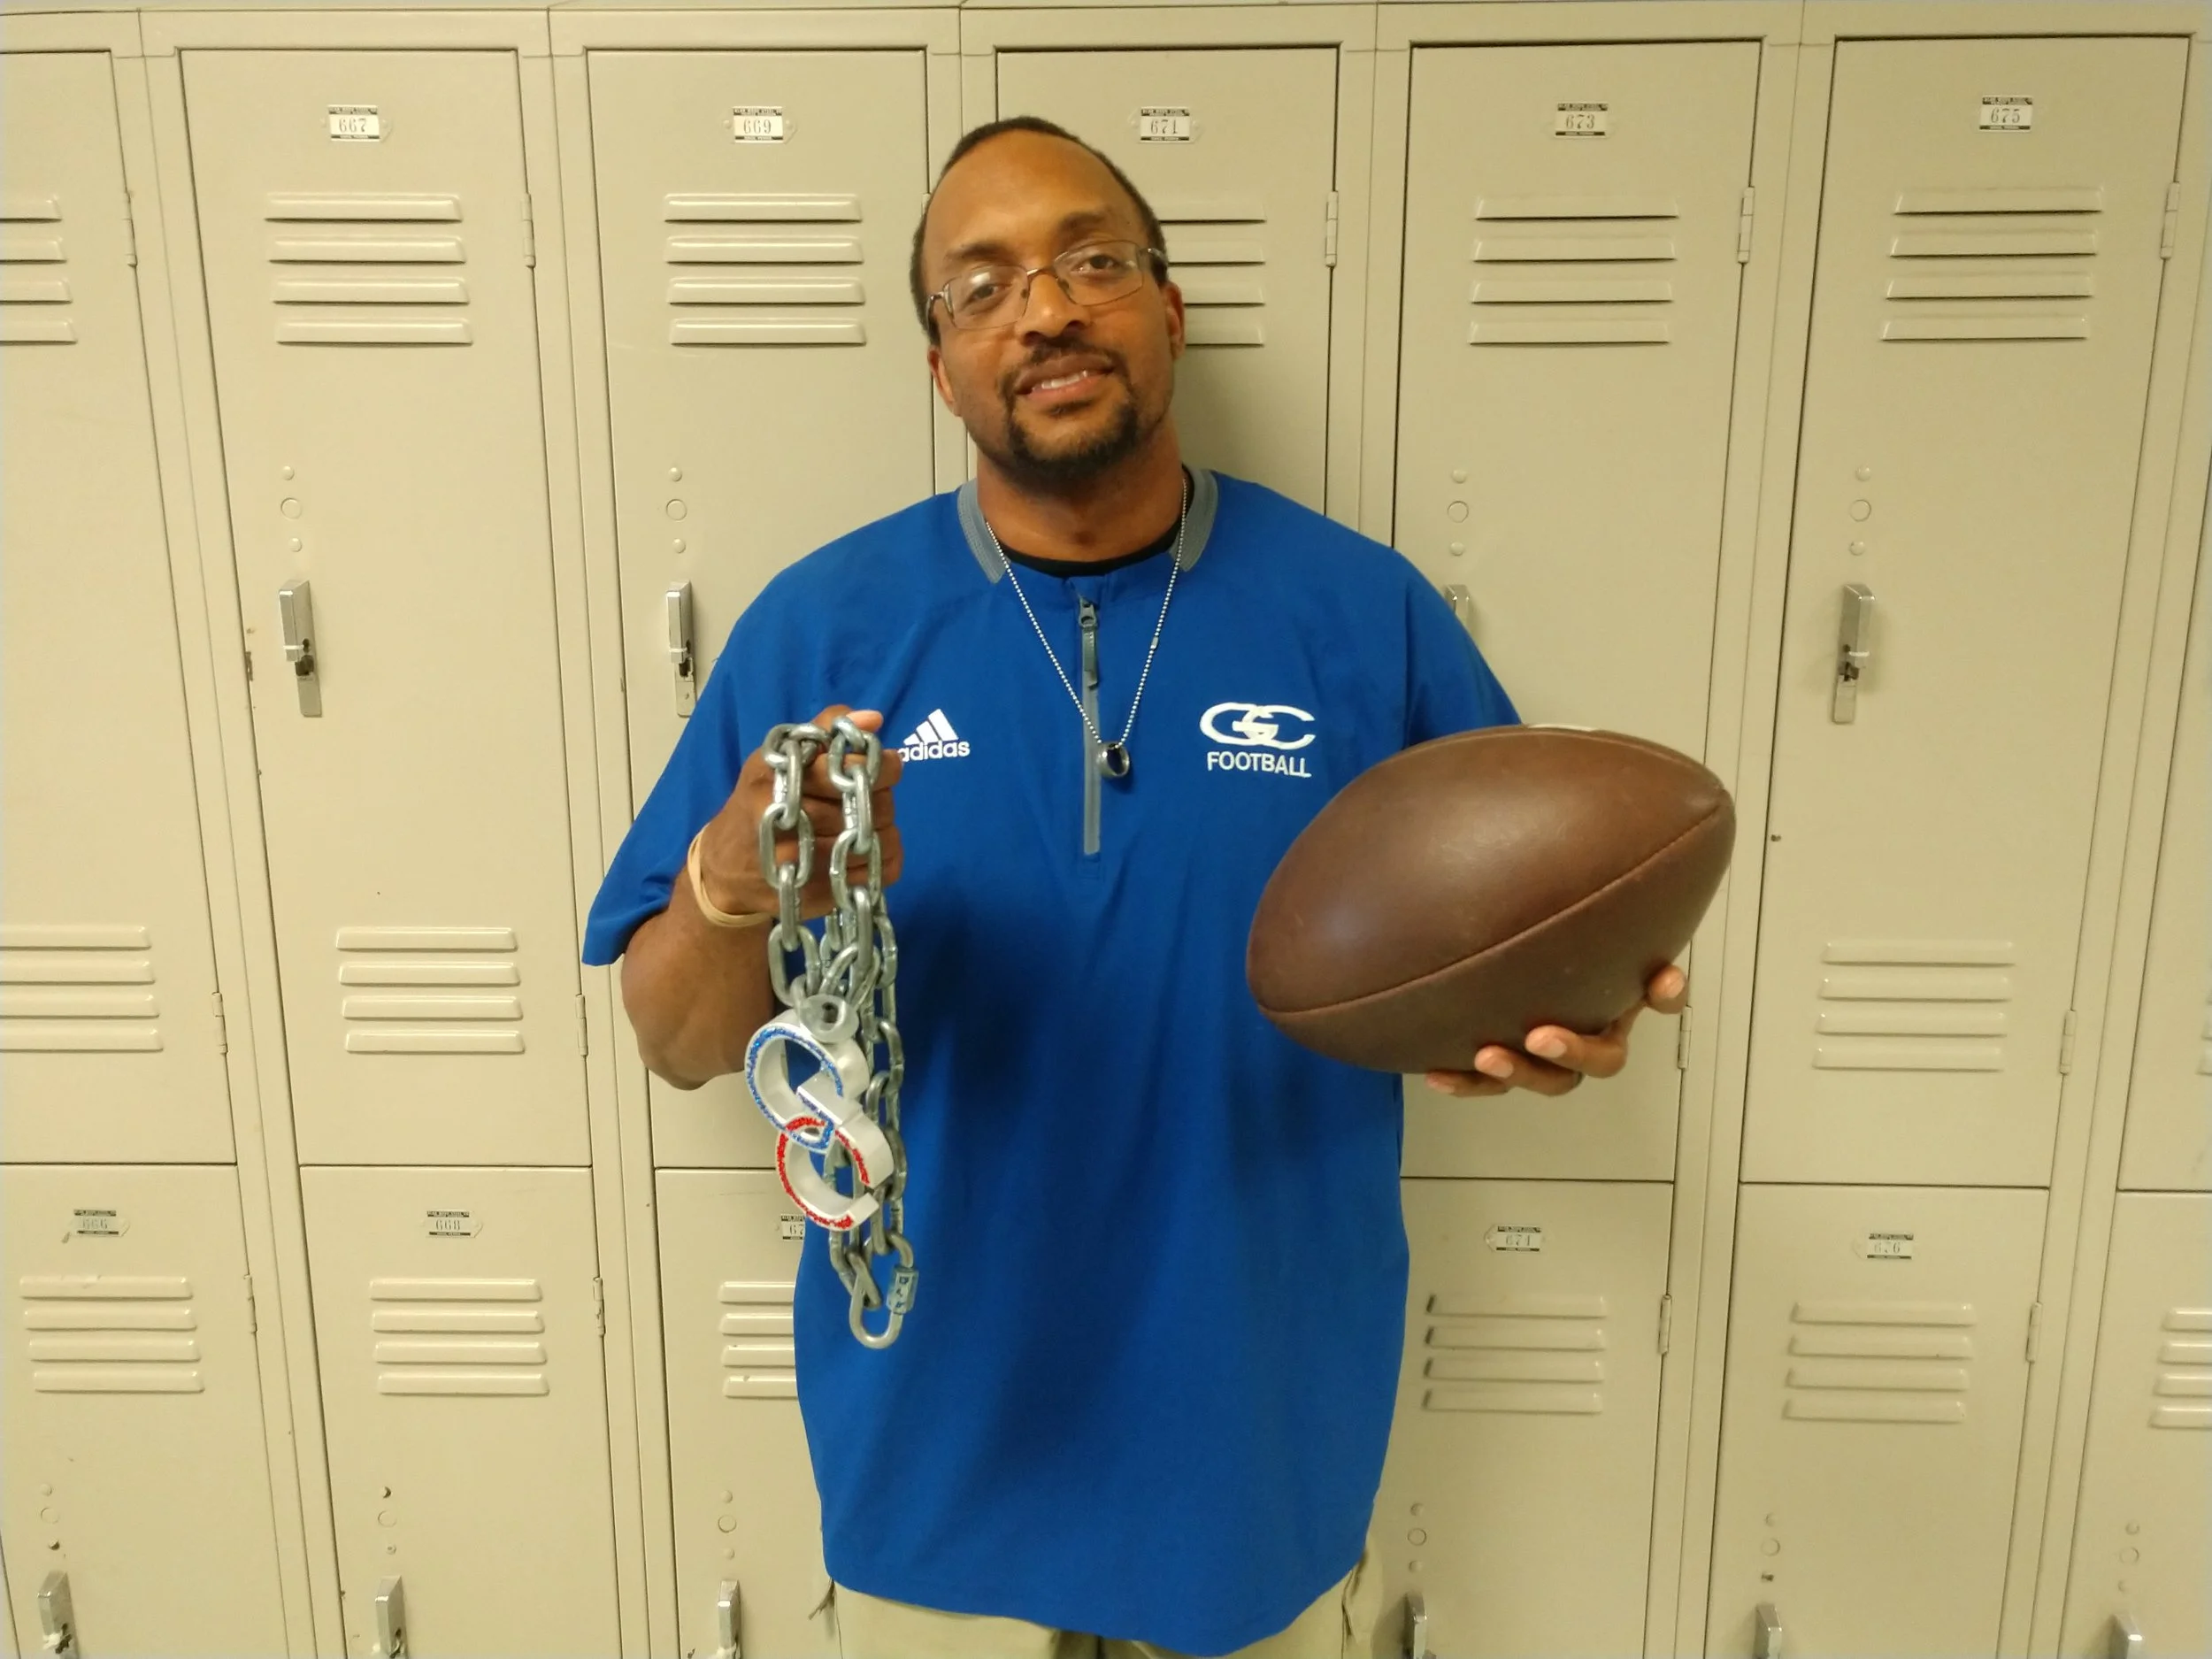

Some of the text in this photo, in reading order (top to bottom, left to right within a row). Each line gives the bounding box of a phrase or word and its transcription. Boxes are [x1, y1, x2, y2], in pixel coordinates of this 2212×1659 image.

[1565, 113, 1595, 129] 673
[1991, 107, 2020, 123] 675
[339, 117, 366, 133] 667
[743, 119, 772, 134] 669
[1150, 119, 1178, 134] 671
[897, 740, 971, 762] adidas
[1207, 750, 1312, 778] FOOTBALL
